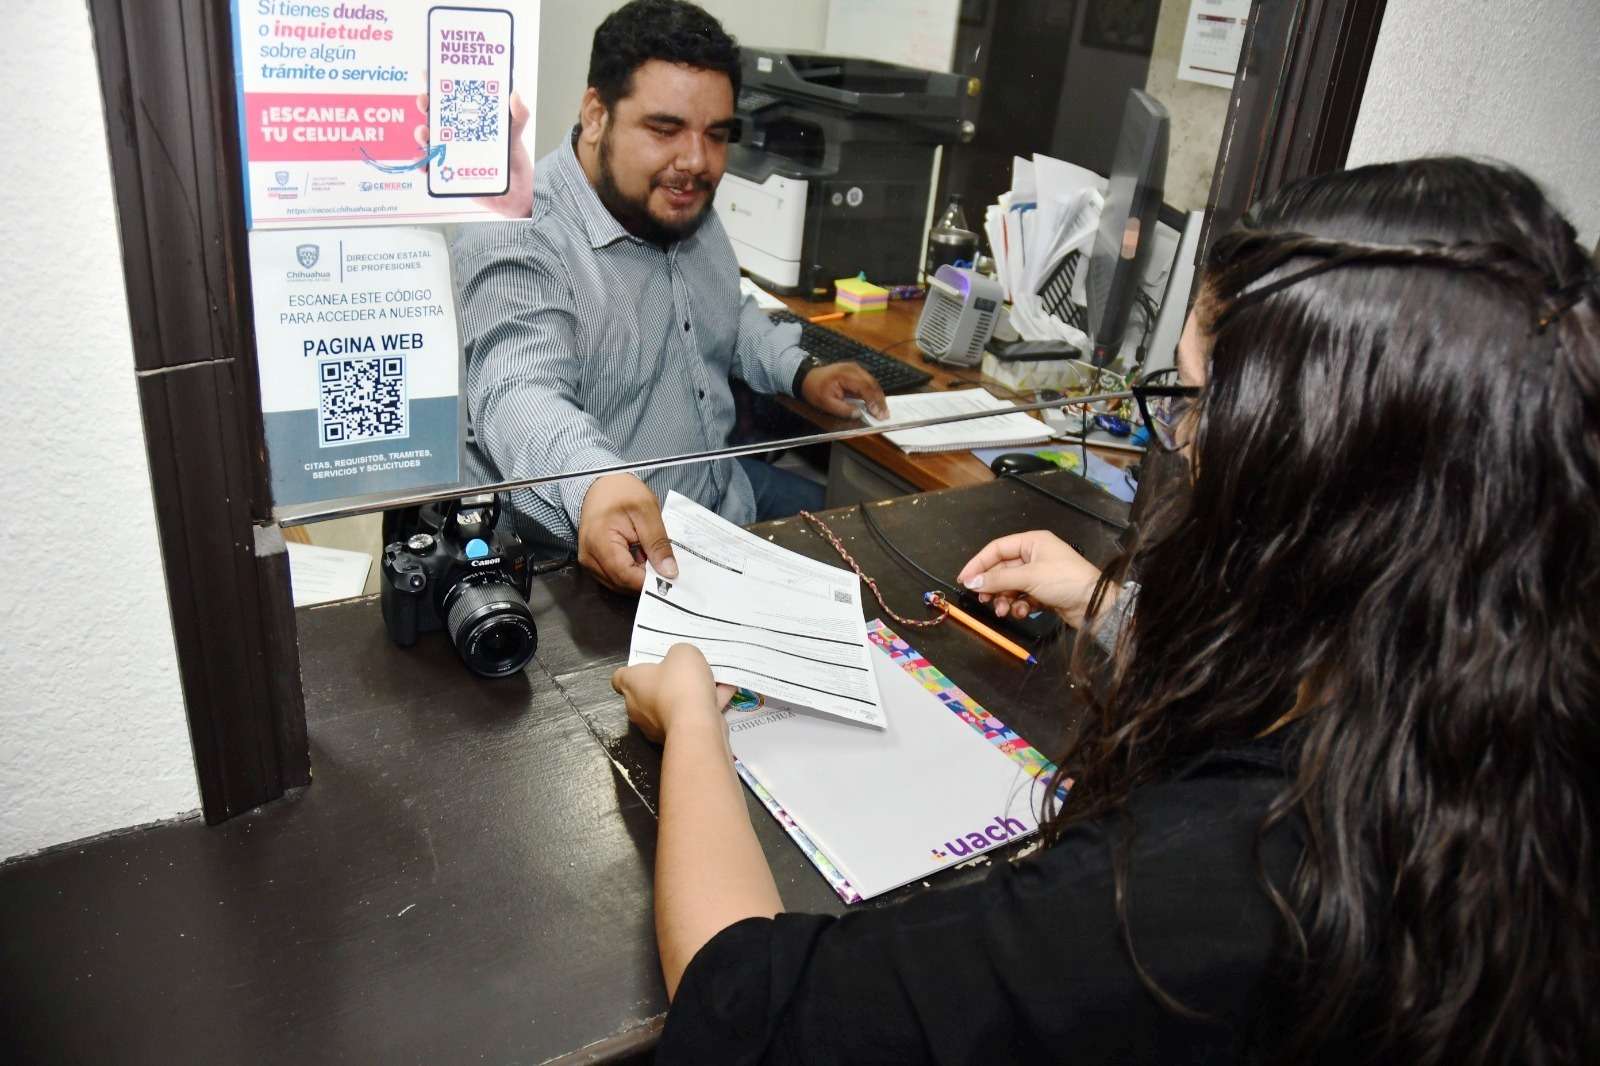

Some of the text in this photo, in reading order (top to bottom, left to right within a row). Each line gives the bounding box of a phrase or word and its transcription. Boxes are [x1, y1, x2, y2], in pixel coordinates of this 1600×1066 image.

[279, 0, 330, 18] tienes
[333, 3, 388, 21] dudas,
[258, 20, 393, 41] o inquietudes
[440, 29, 486, 41] VISITA
[260, 42, 356, 62] sobre algún
[440, 42, 505, 54] NUESTRO
[440, 54, 494, 65] PORTAL
[261, 63, 408, 81] trámite o servicio:
[261, 106, 405, 126] ¡ESCANEA CON
[261, 126, 384, 142] TU CELULAR!
[457, 167, 498, 176] CECOCI
[397, 250, 432, 260] ESTATAL
[286, 271, 331, 279] Chihuahua
[346, 261, 422, 272] DE PROFESIONES
[288, 288, 432, 307] ESCANEA ESTE CÓDIGO
[280, 305, 444, 325] PARA ACCEDER A NUESTRA
[303, 333, 424, 357] PAGINA WEB
[304, 461, 333, 471] CITAS,
[334, 454, 387, 467] REQUISITOS,
[312, 459, 422, 479] SERVICIOS Y SOLICITUDES
[471, 557, 501, 567] Canon
[944, 816, 1028, 856] uach
